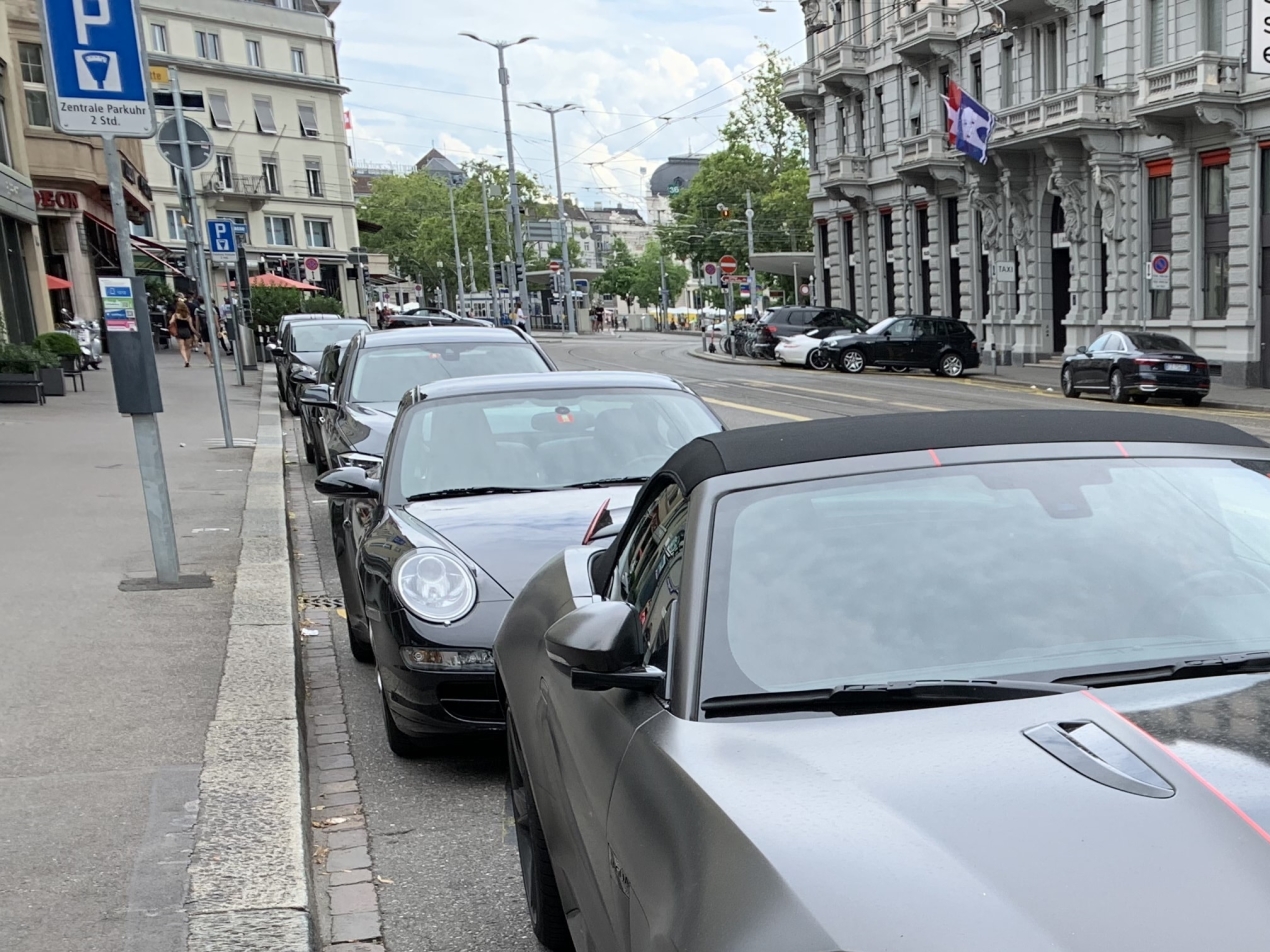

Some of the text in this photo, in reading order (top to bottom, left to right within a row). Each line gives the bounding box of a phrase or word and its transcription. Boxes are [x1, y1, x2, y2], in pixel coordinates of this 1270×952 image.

[61, 102, 146, 115] Zentrale Parkuhr
[90, 116, 121, 126] 2 Std.
[214, 223, 227, 239] P
[998, 265, 1014, 273] TAXI
